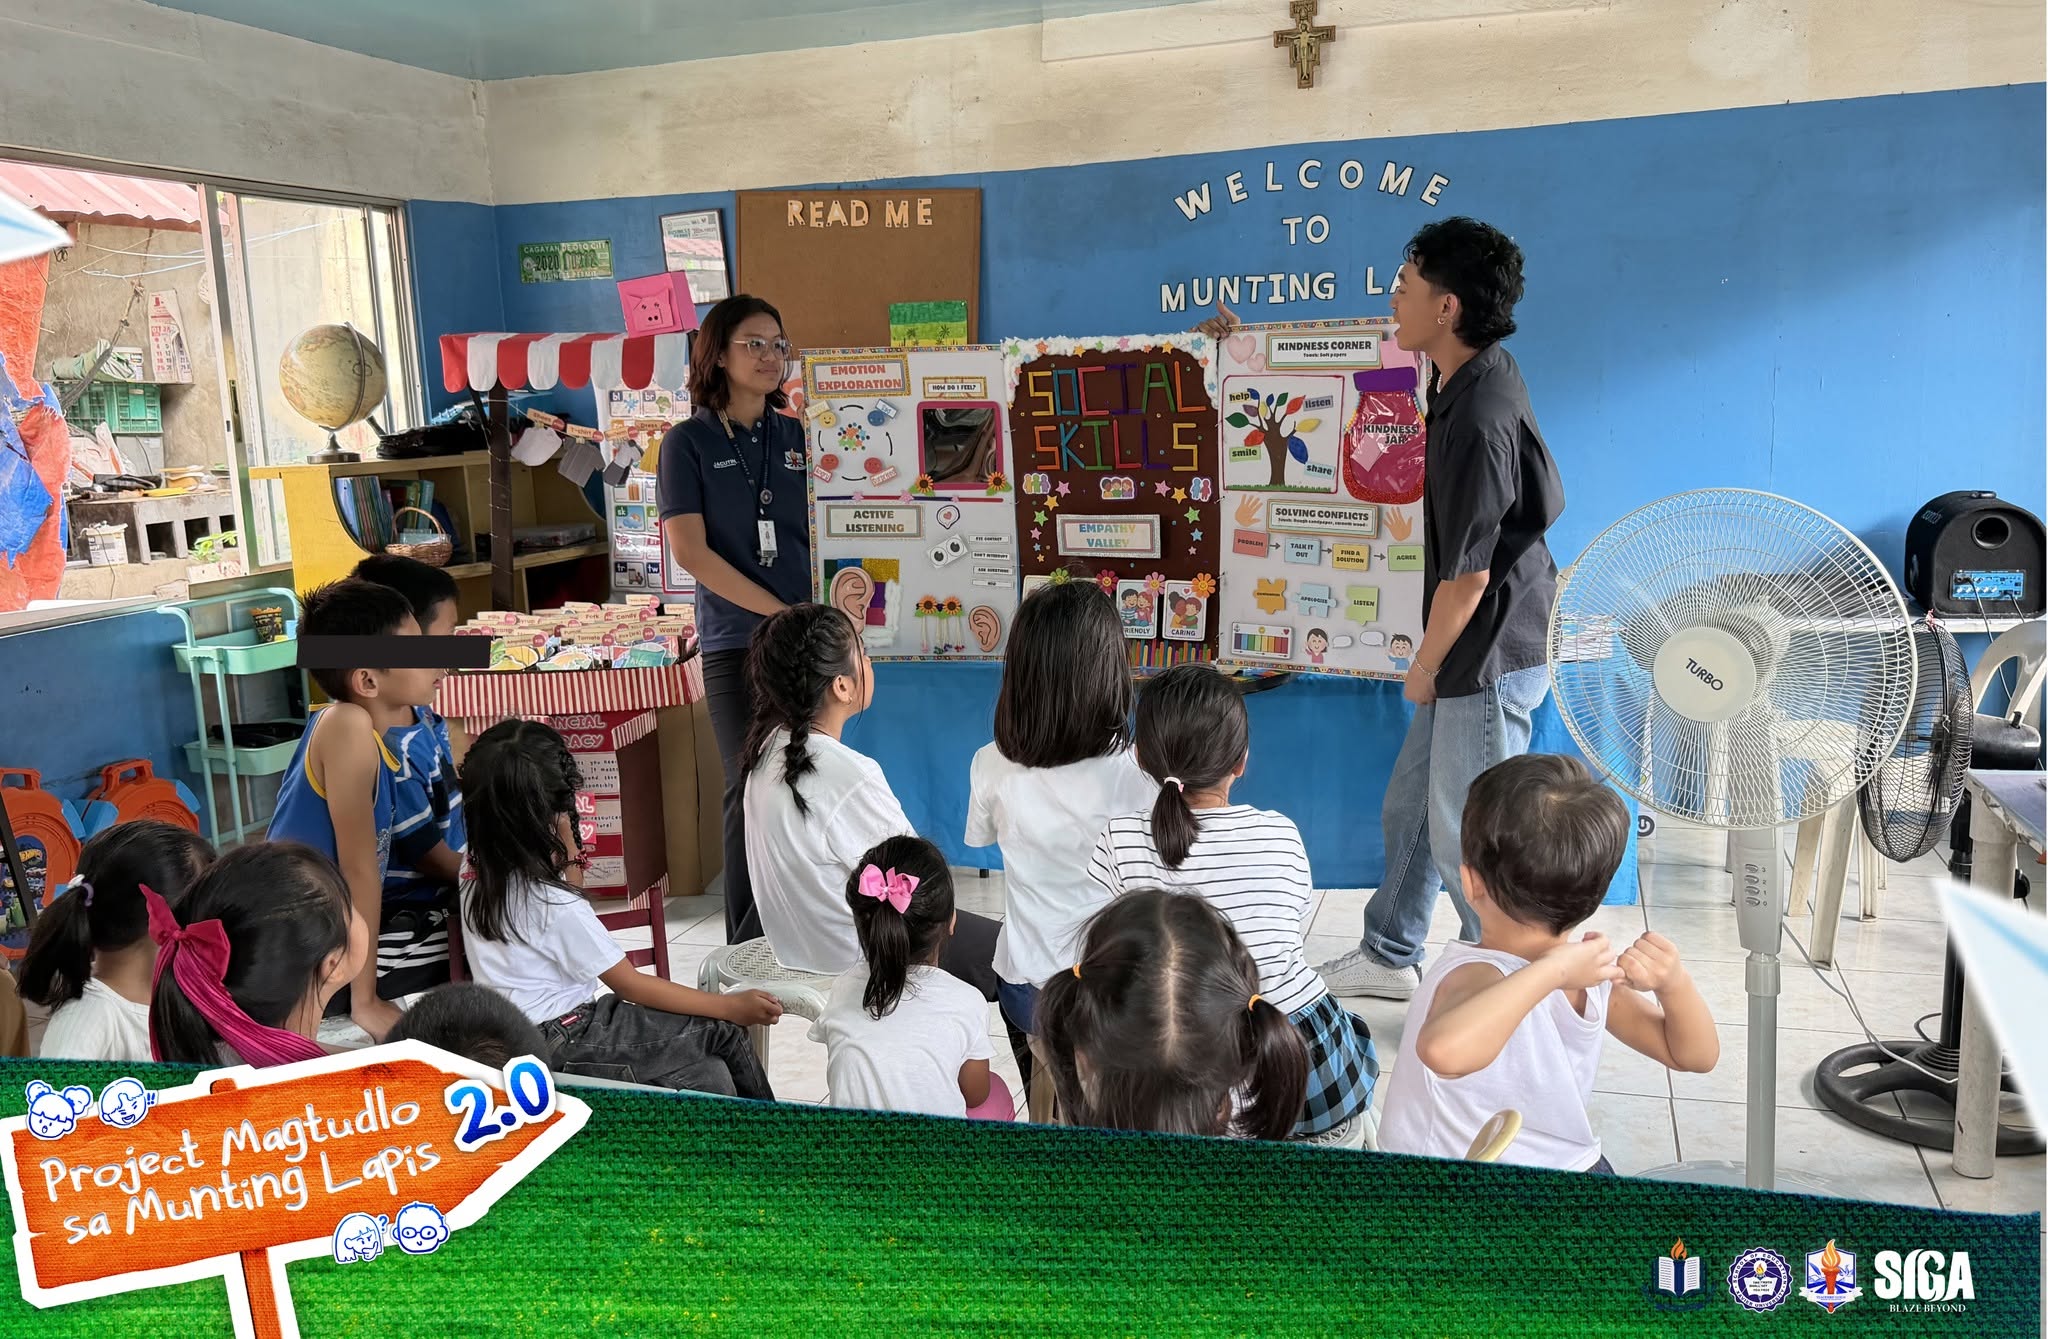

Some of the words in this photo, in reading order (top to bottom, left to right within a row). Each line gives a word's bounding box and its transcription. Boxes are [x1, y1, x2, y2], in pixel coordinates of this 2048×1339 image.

[1174, 159, 1449, 221] WELCOME
[787, 199, 870, 228] READ
[885, 198, 933, 228] ME
[1281, 214, 1331, 246] TO
[523, 245, 560, 254] CAGAYAN
[1160, 271, 1337, 313] MUNTING
[1365, 264, 1405, 295] LA
[1277, 341, 1330, 351] KINDNESS
[1331, 340, 1372, 350] CORNER
[830, 364, 886, 376] EMOTION
[817, 378, 902, 391] EXPLORATION
[1028, 360, 1207, 417] SOCIAL
[1229, 391, 1250, 402] help
[1304, 398, 1331, 409] listen
[1363, 424, 1419, 435] KINDNESS
[1384, 434, 1407, 444] JAR
[1034, 419, 1199, 472] SKILLS
[1231, 448, 1258, 458] smile
[1306, 463, 1333, 475] share
[853, 510, 894, 519] ACTIVE
[1275, 507, 1316, 518] SOLVING
[1317, 510, 1369, 521] CONFLICTS
[845, 523, 905, 533] LISTENING
[1079, 523, 1136, 534] EMPATHY
[1086, 538, 1129, 548] VALLEY
[1237, 539, 1264, 547] PROBLEM
[1336, 556, 1364, 564] SOLUTION
[1353, 599, 1375, 607] LISTEN
[1685, 657, 1724, 691] TURBO
